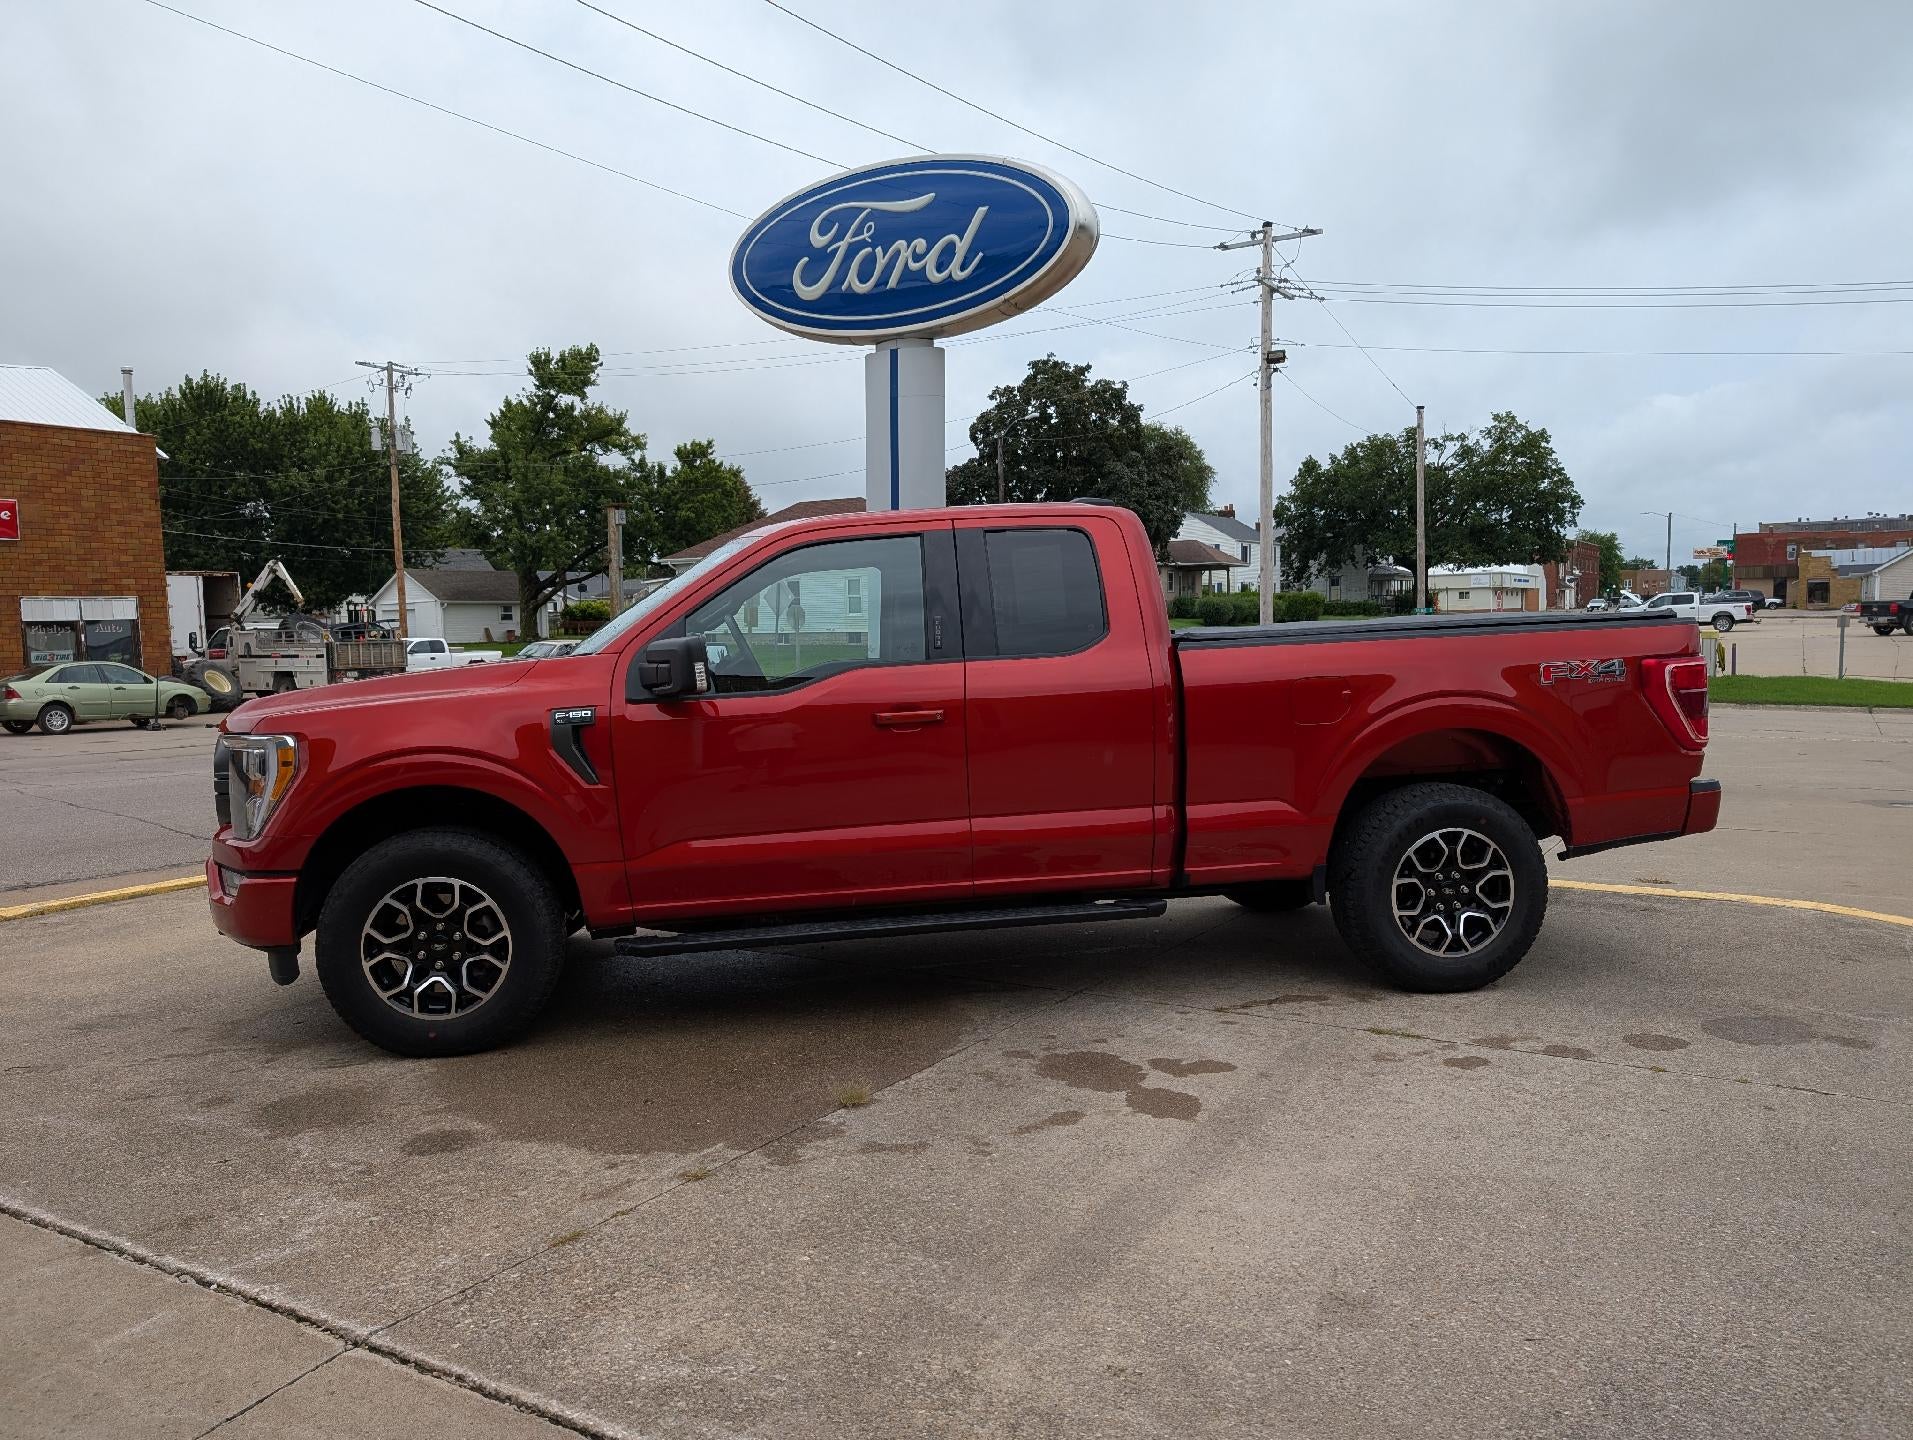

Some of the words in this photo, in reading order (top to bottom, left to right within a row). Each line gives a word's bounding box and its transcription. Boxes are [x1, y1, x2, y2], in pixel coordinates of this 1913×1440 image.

[793, 192, 989, 300] Ford
[31, 624, 71, 636] Phelps
[95, 622, 123, 633] Auto
[1540, 659, 1626, 686] FX4
[555, 710, 592, 719] F-150
